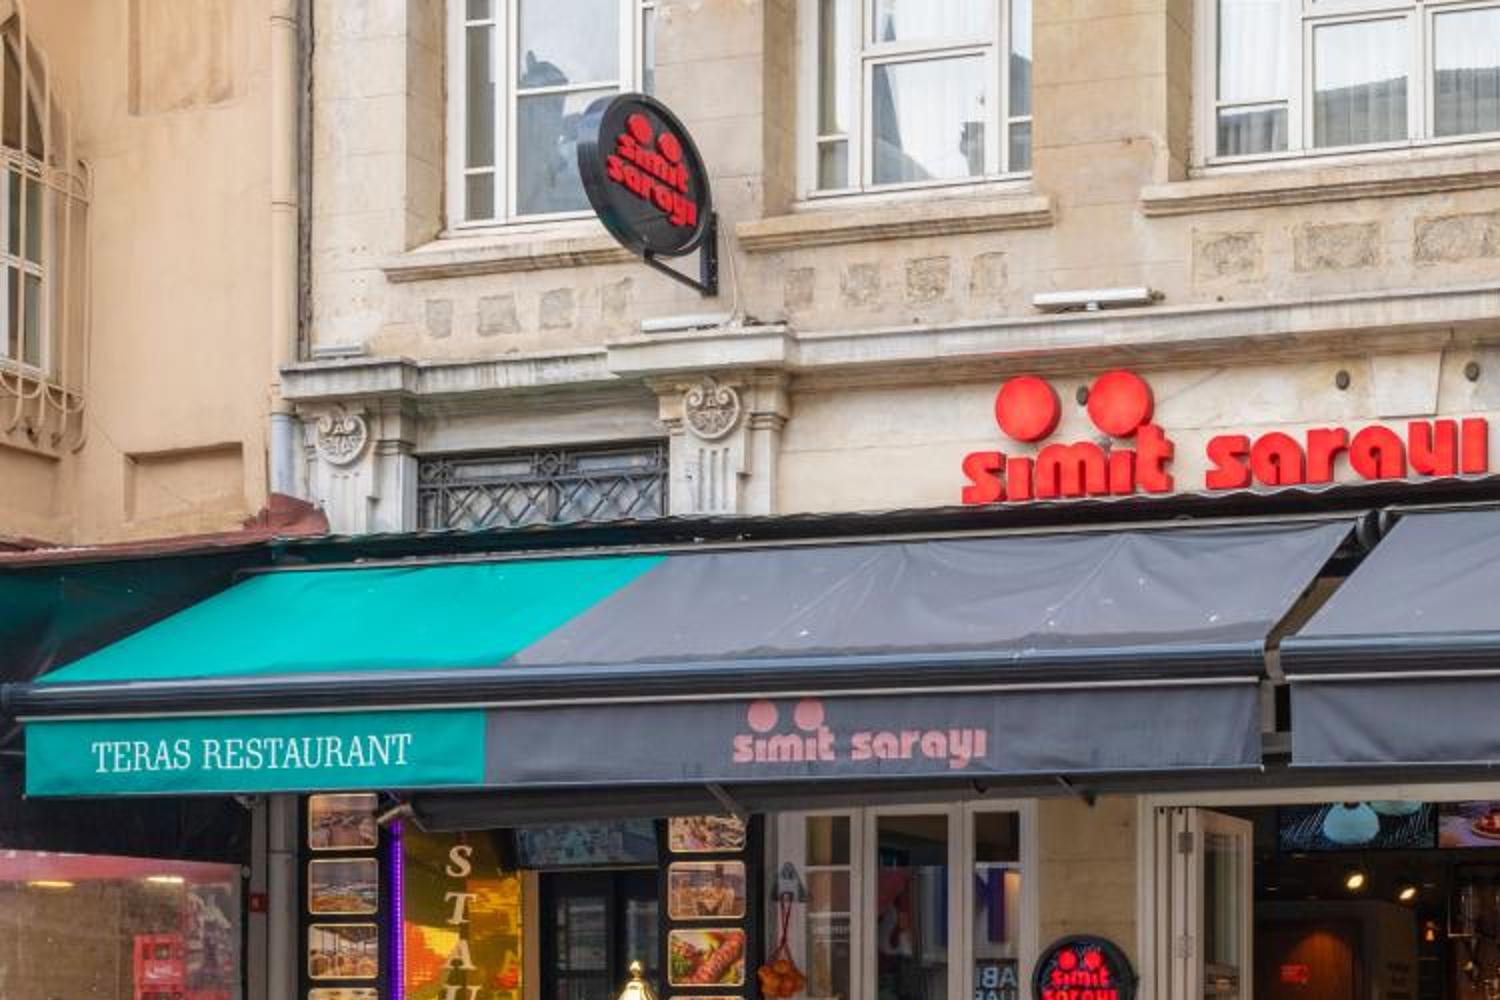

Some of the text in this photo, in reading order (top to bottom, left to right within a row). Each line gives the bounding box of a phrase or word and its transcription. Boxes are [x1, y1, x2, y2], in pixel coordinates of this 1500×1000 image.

[616, 113, 690, 194] simit
[961, 369, 1174, 504] simit
[91, 733, 411, 773] TERAS RESTAURANT
[733, 700, 835, 762] simit
[1050, 949, 1109, 986] simit
